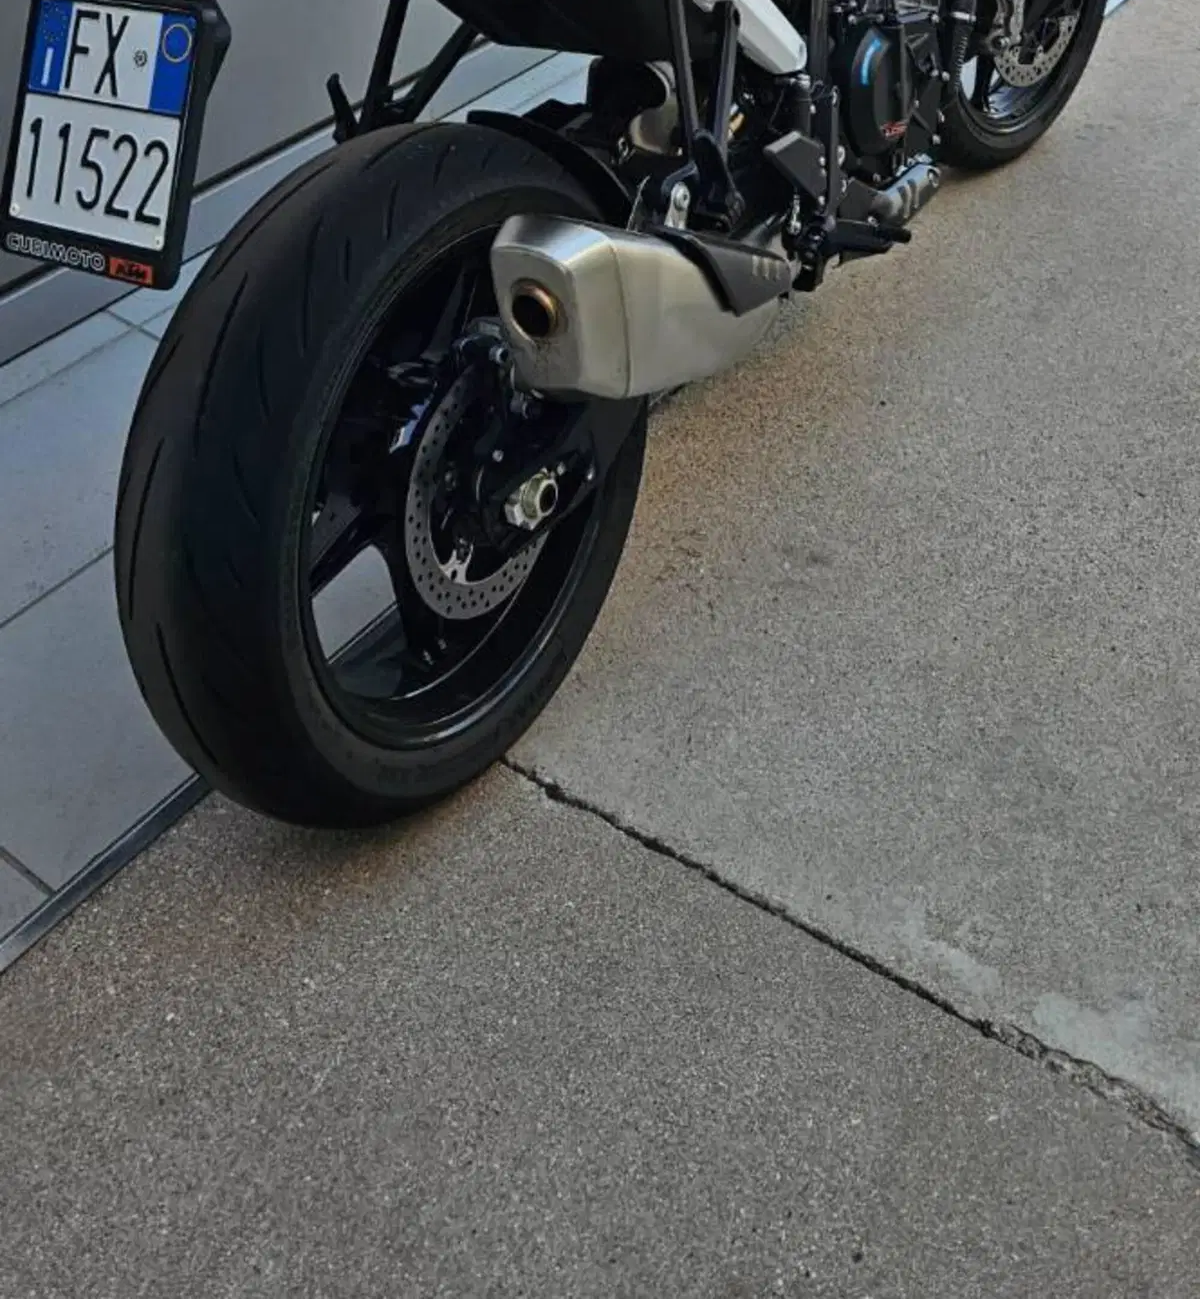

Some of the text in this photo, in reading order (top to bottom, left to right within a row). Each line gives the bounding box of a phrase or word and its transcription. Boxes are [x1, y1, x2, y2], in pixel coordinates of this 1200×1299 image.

[64, 8, 130, 98] FX
[26, 116, 170, 227] 11522
[6, 231, 106, 272] CUBIMOTO
